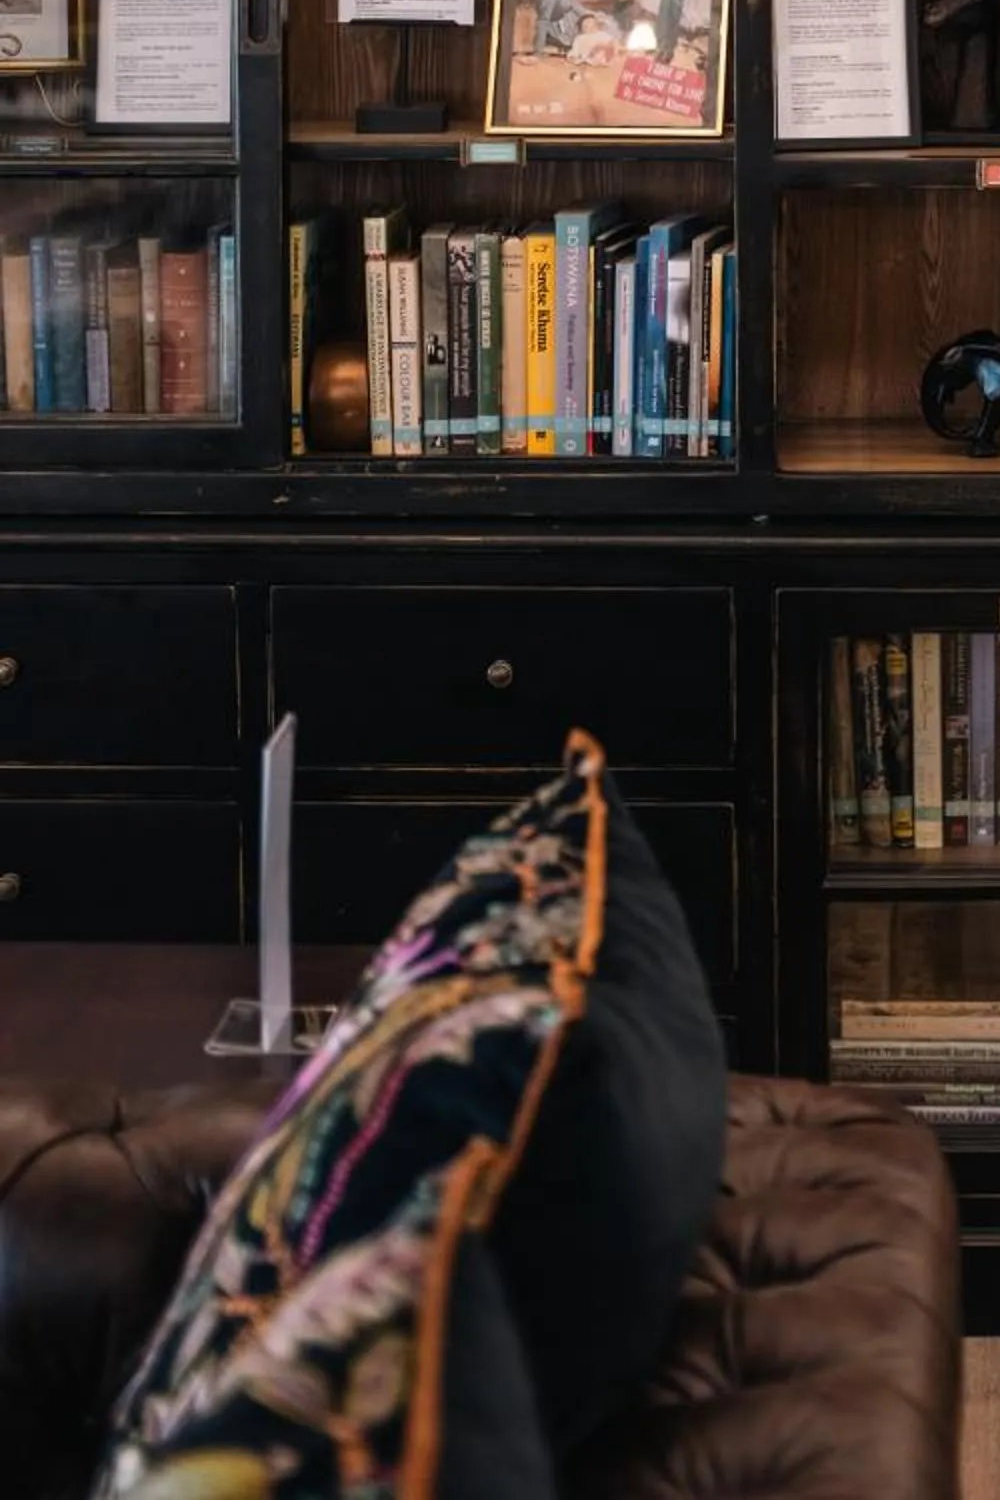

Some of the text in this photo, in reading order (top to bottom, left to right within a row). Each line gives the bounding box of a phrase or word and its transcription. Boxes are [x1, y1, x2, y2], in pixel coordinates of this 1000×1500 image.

[537, 262, 551, 352] Seretse Khama
[566, 225, 579, 307] BOTSWANA
[399, 353, 411, 402] COLOUR
